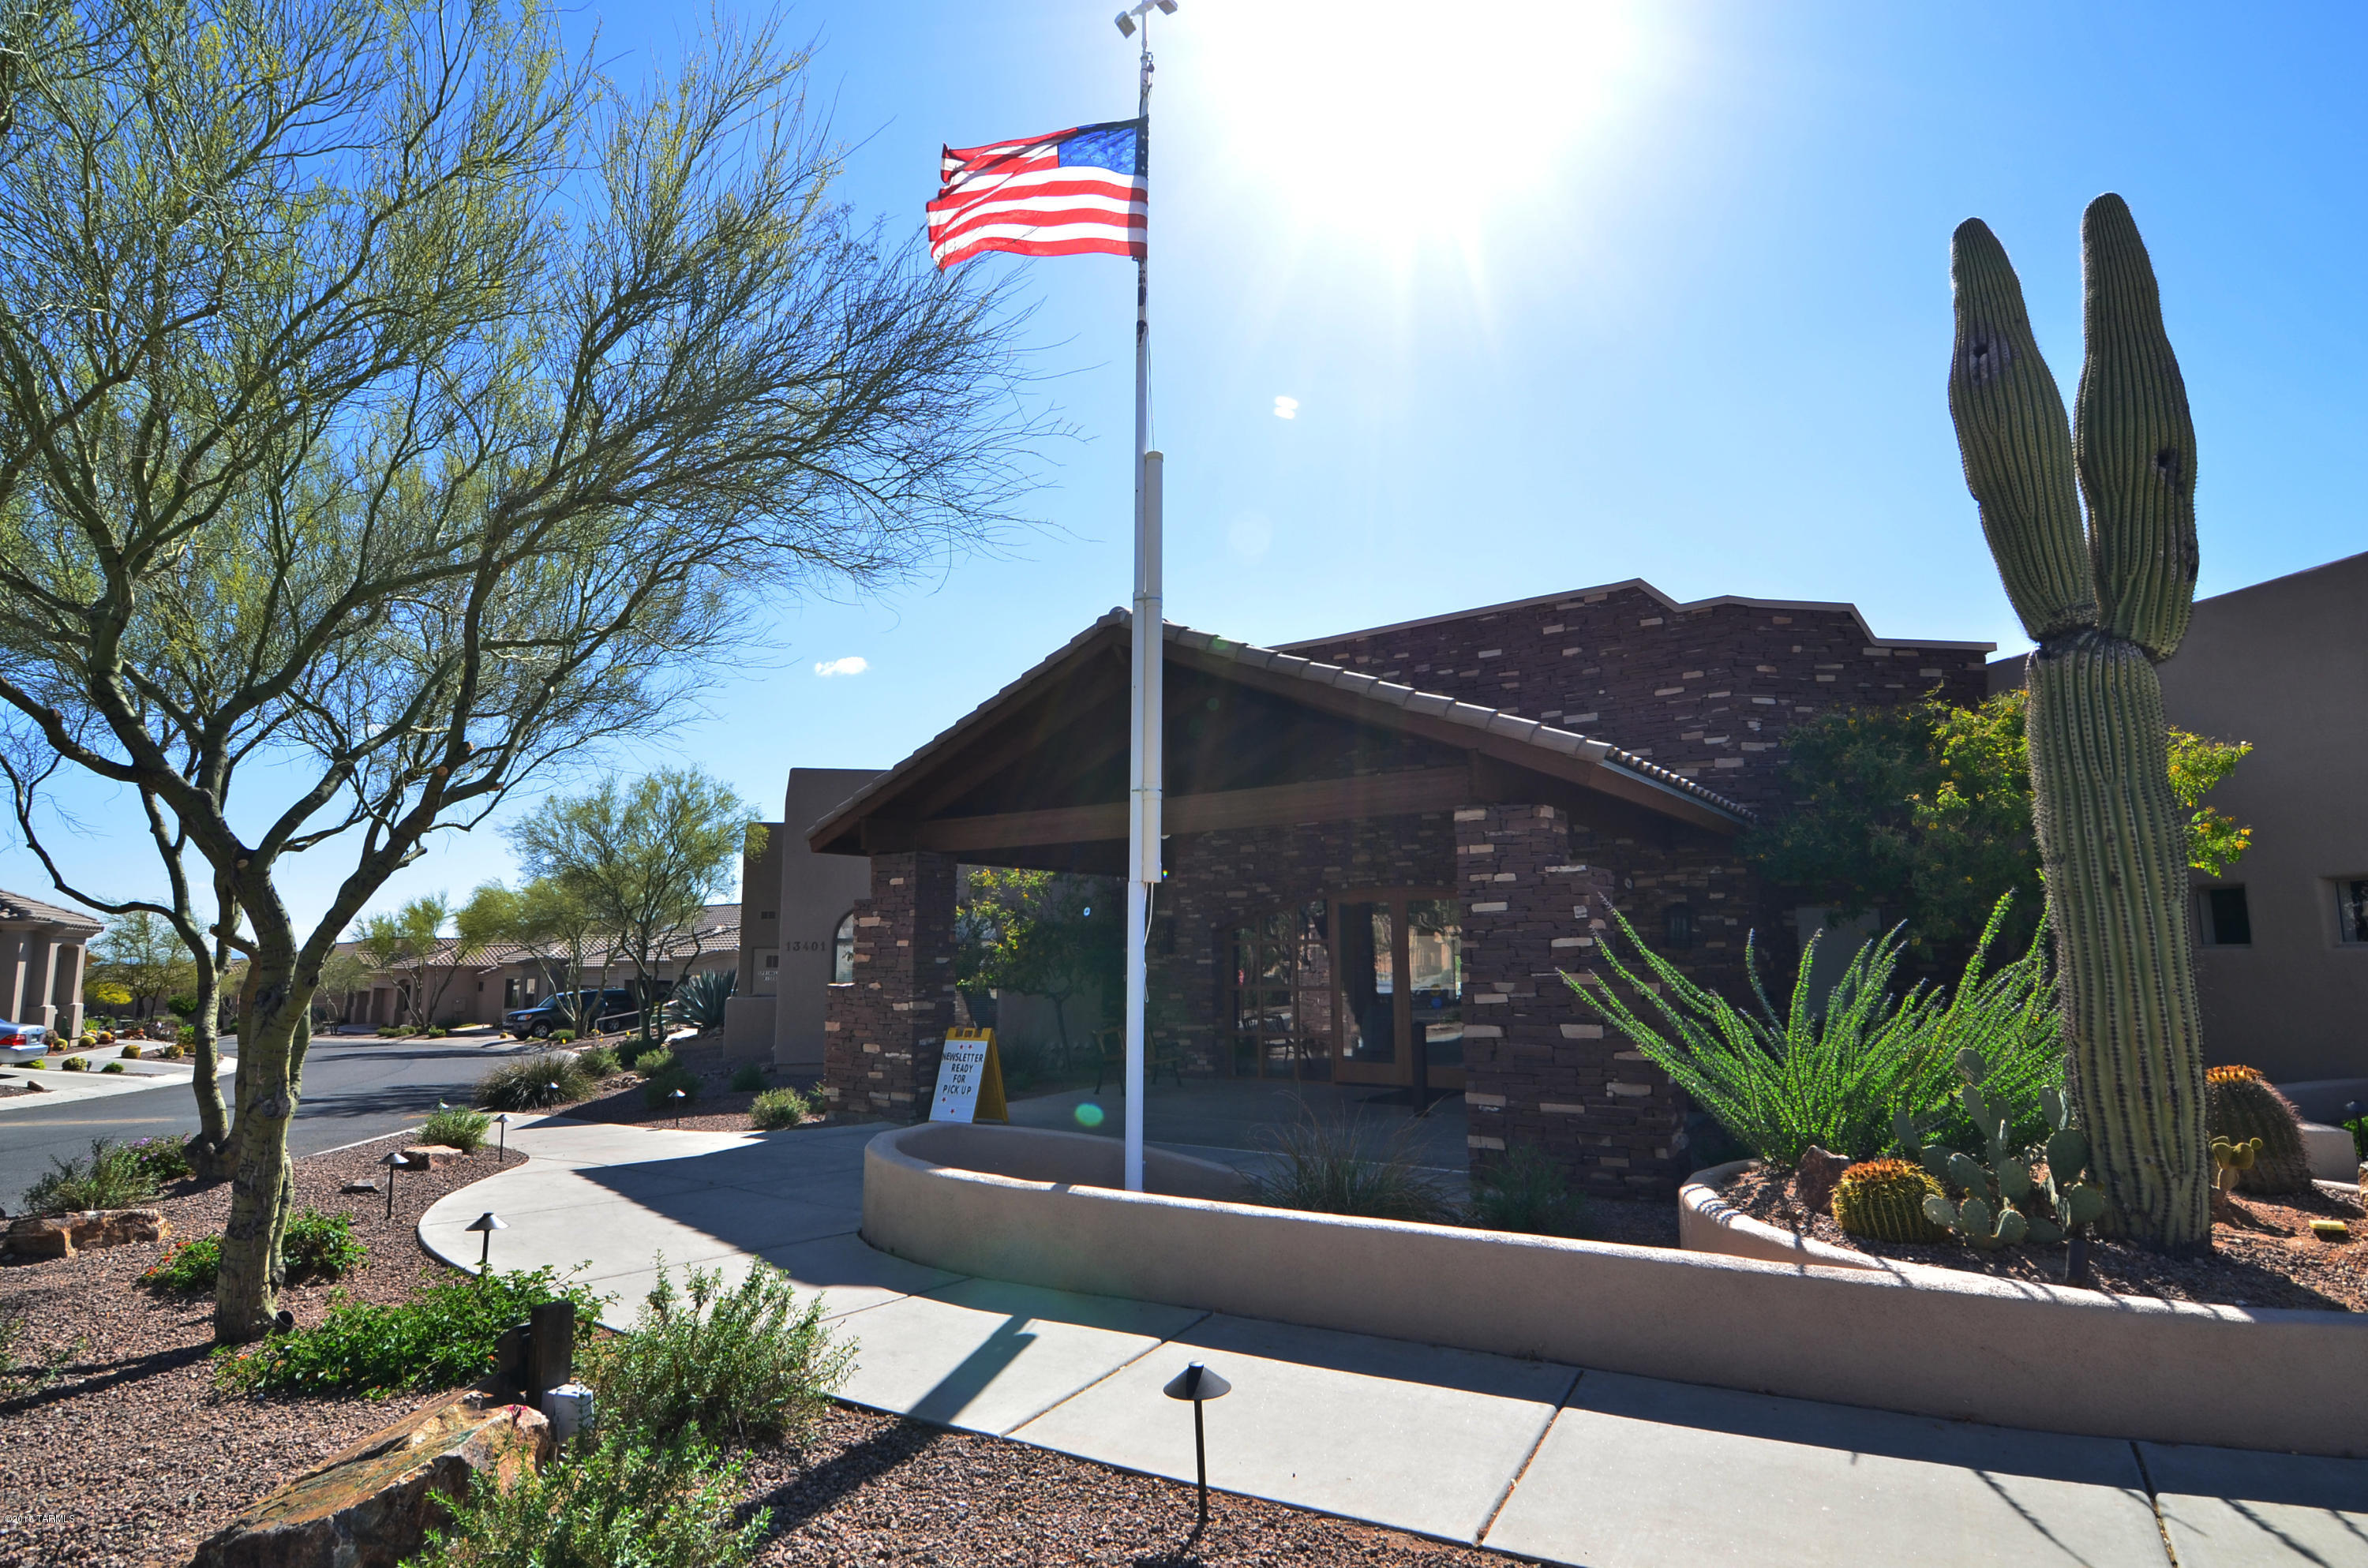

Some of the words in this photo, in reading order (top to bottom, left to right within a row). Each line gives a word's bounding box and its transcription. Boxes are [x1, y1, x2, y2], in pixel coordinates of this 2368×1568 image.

[786, 941, 826, 952] 13401
[942, 1052, 984, 1063] NEWSLETTER
[951, 1063, 974, 1073] READY
[952, 1074, 966, 1083] FOR
[942, 1084, 960, 1095] PICK
[961, 1086, 972, 1095] UP
